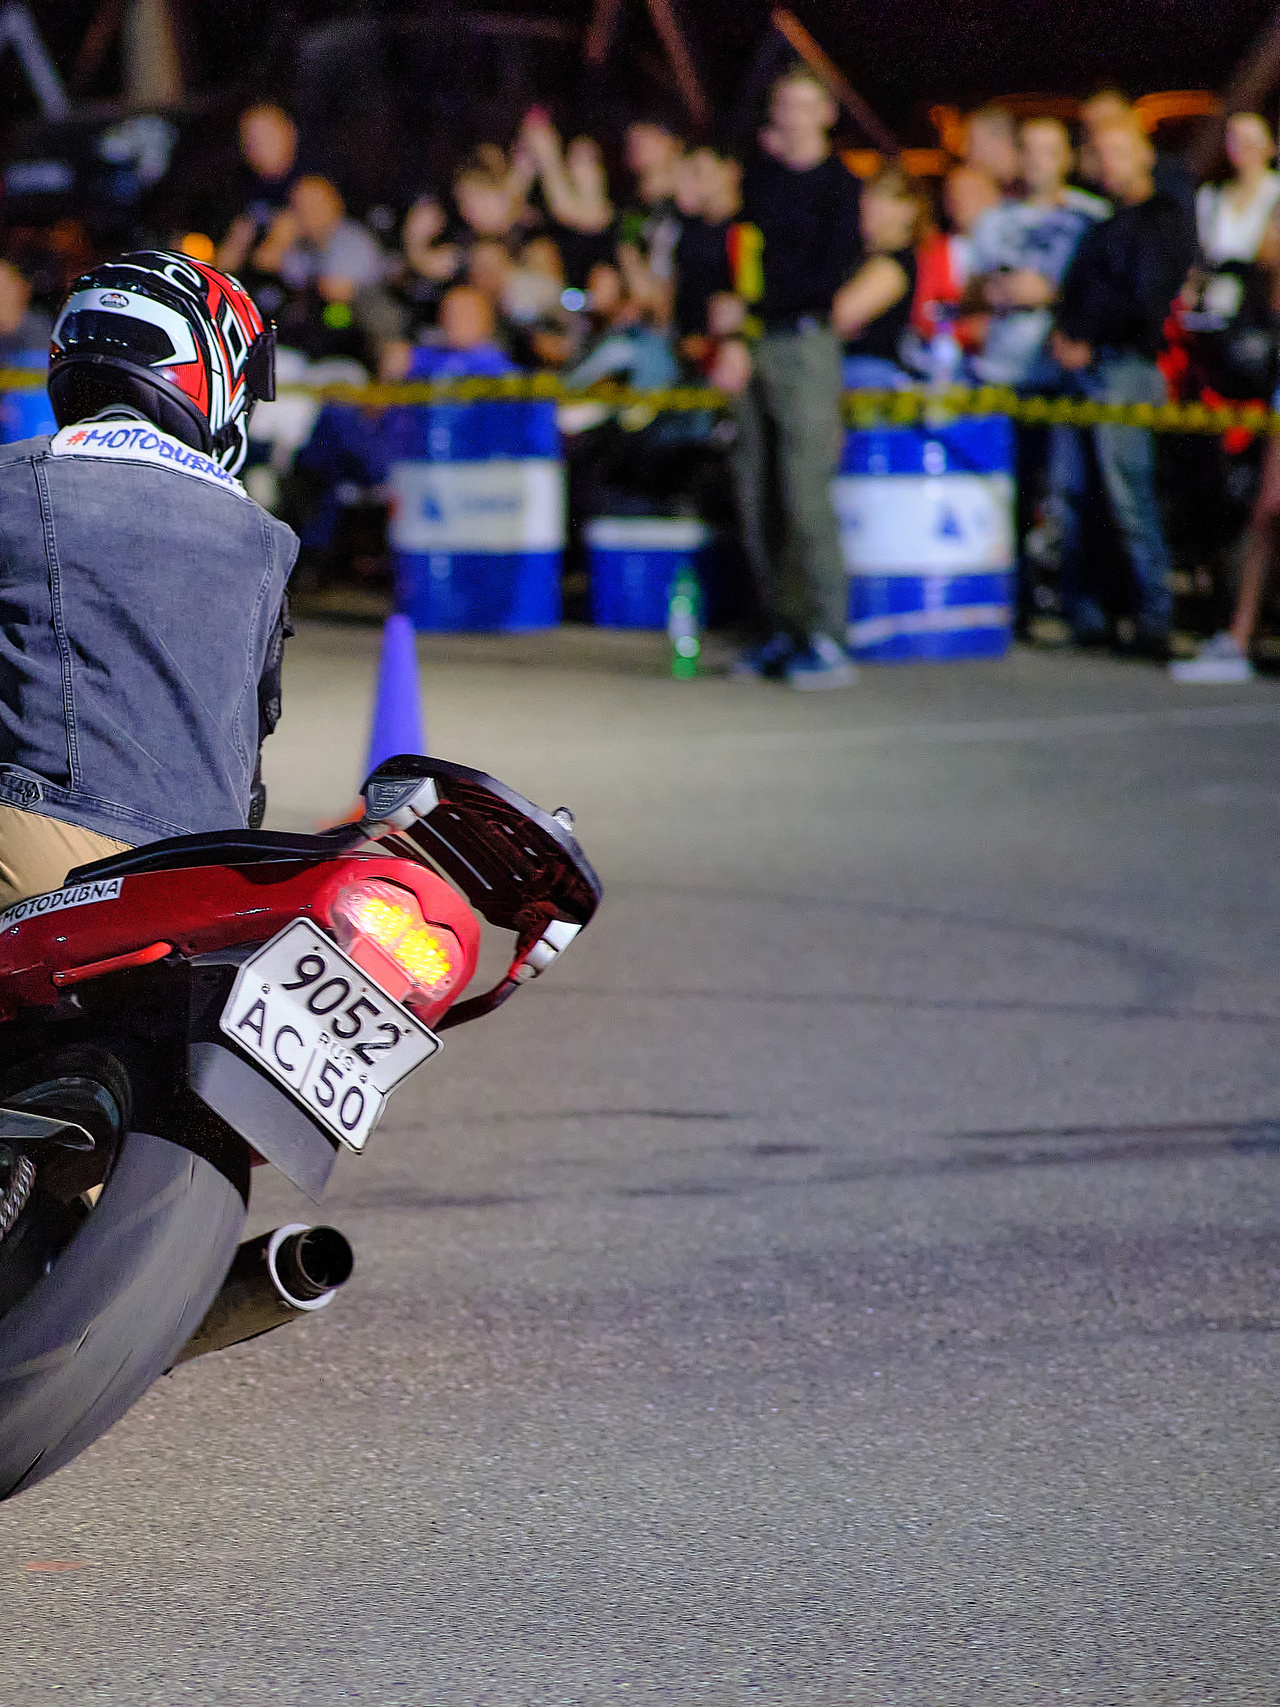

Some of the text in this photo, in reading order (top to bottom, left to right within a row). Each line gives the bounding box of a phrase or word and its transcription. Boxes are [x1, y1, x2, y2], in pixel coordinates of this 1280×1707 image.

[237, 998, 365, 1131] AC 50
[280, 954, 402, 1066] 9052
